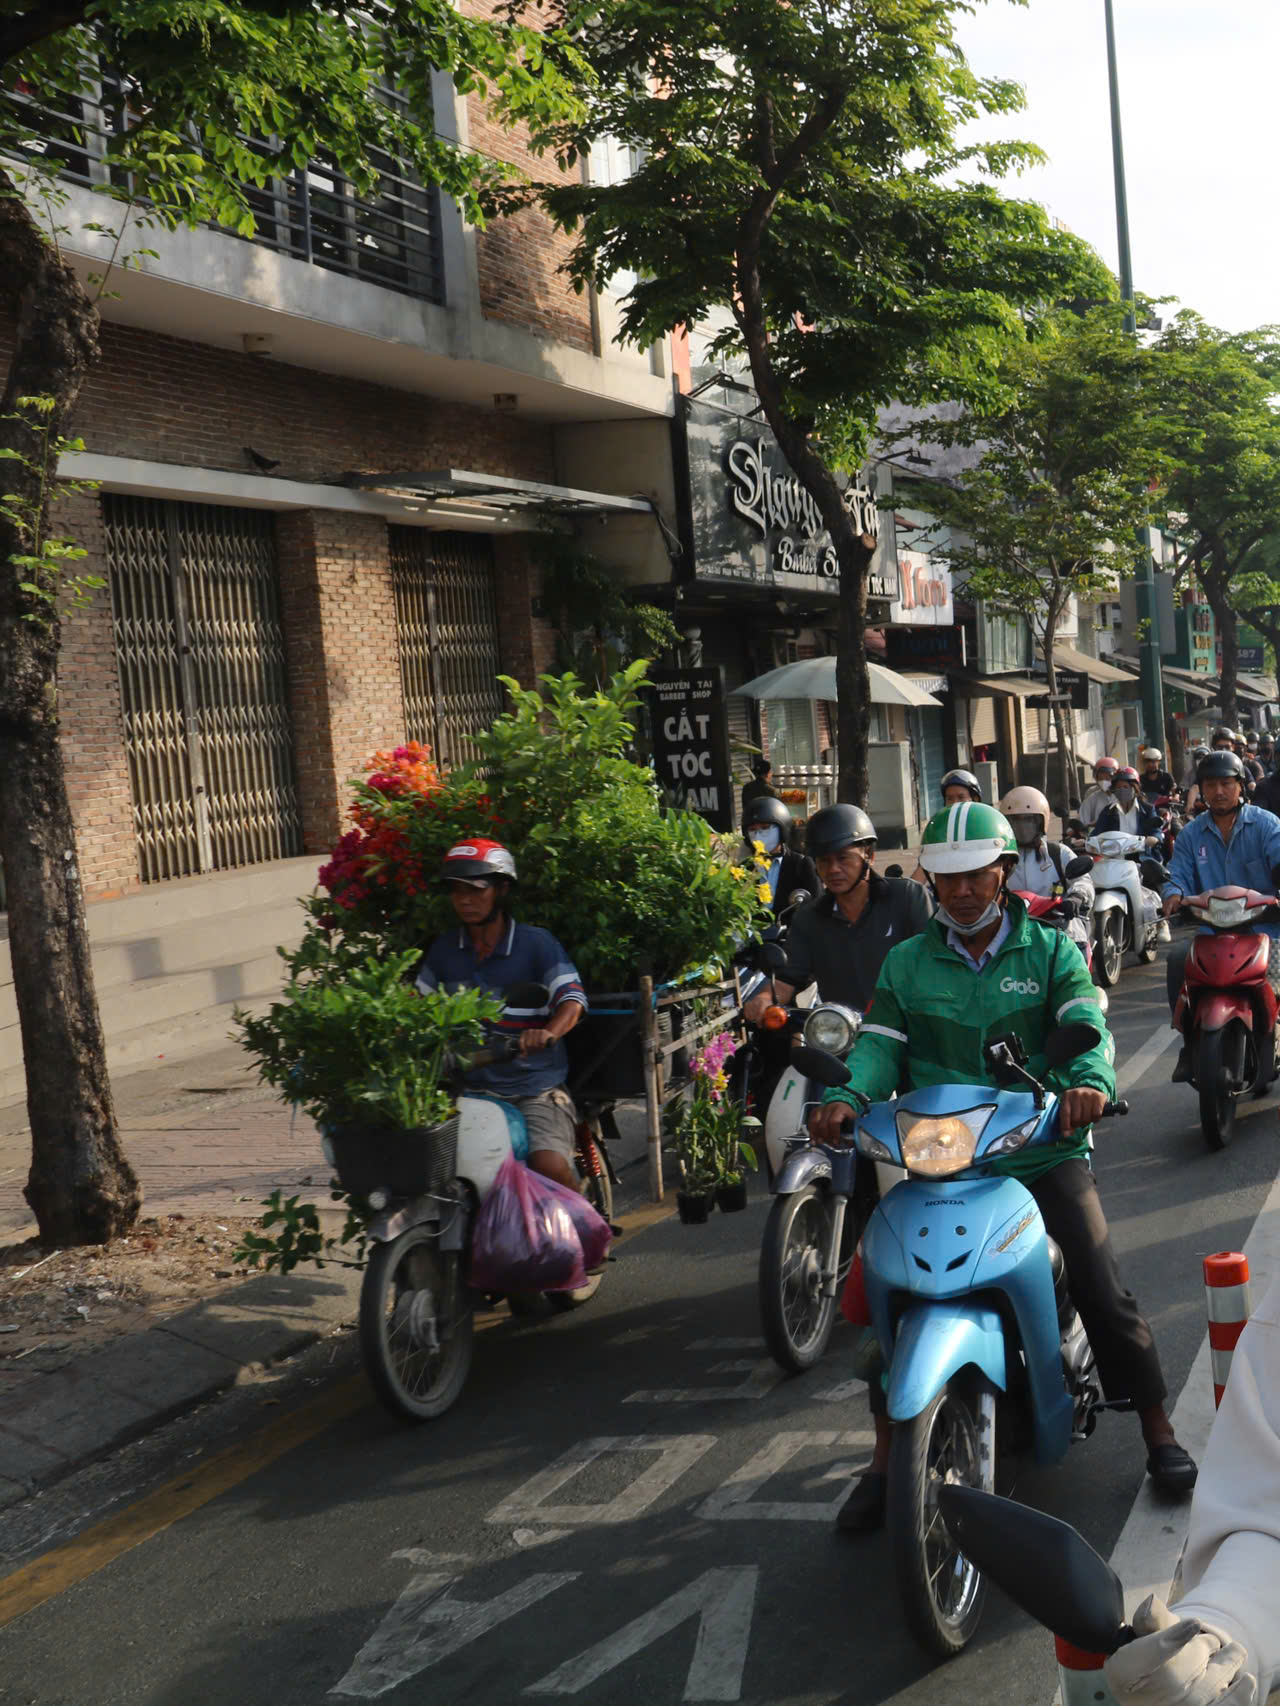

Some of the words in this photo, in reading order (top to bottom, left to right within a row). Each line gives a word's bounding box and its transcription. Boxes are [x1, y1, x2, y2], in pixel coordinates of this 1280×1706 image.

[692, 690, 711, 699] SHOP
[663, 707, 710, 741] CẮT
[667, 748, 712, 779] TÓC
[1000, 976, 1040, 995] Grab
